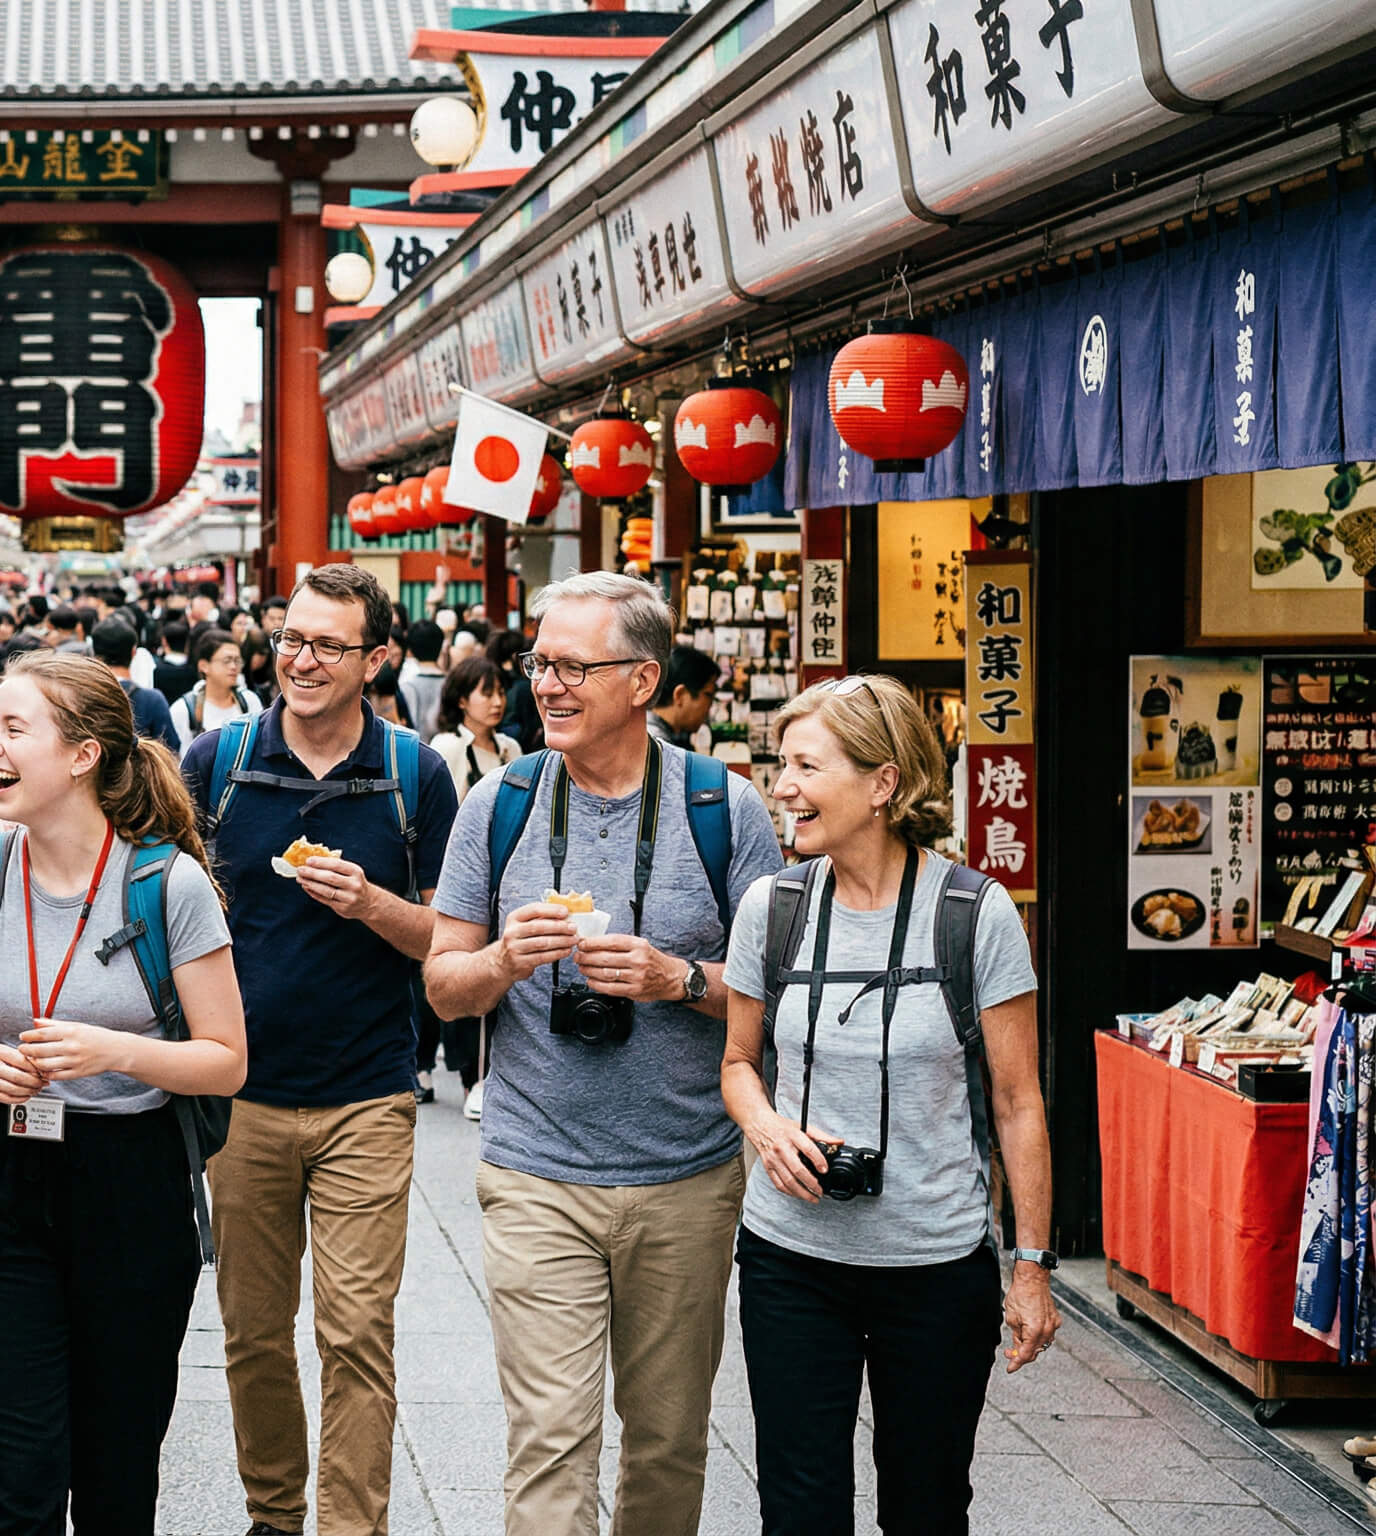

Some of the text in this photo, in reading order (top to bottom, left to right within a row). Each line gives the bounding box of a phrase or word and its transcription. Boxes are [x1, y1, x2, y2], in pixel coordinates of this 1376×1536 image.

[1232, 268, 1256, 447] 和菓子
[976, 581, 1023, 735] 和菓子
[975, 755, 1028, 875] 焼鳥
